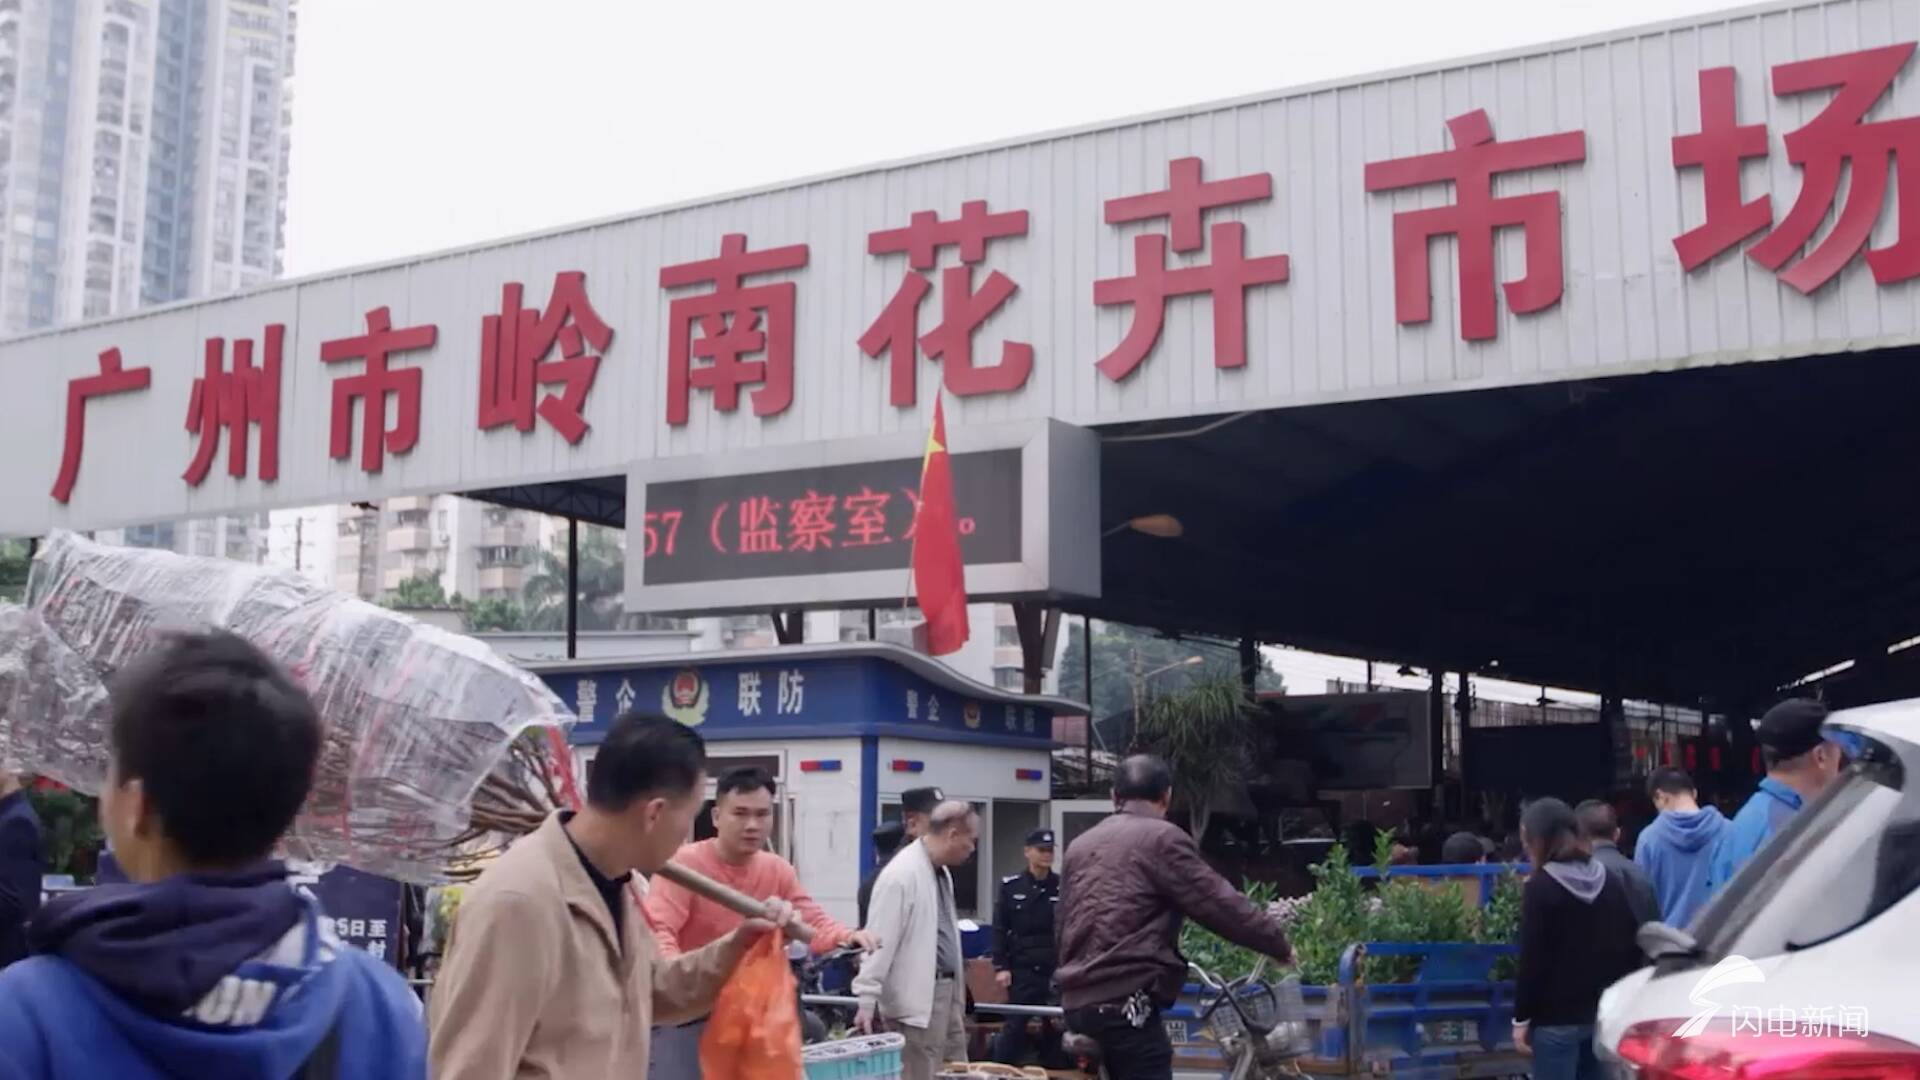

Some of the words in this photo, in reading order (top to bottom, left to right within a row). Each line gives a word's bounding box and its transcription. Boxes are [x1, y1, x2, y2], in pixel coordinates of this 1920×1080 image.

[51, 41, 1920, 503] 广州市岭南花卉市场
[738, 669, 804, 717] 联防
